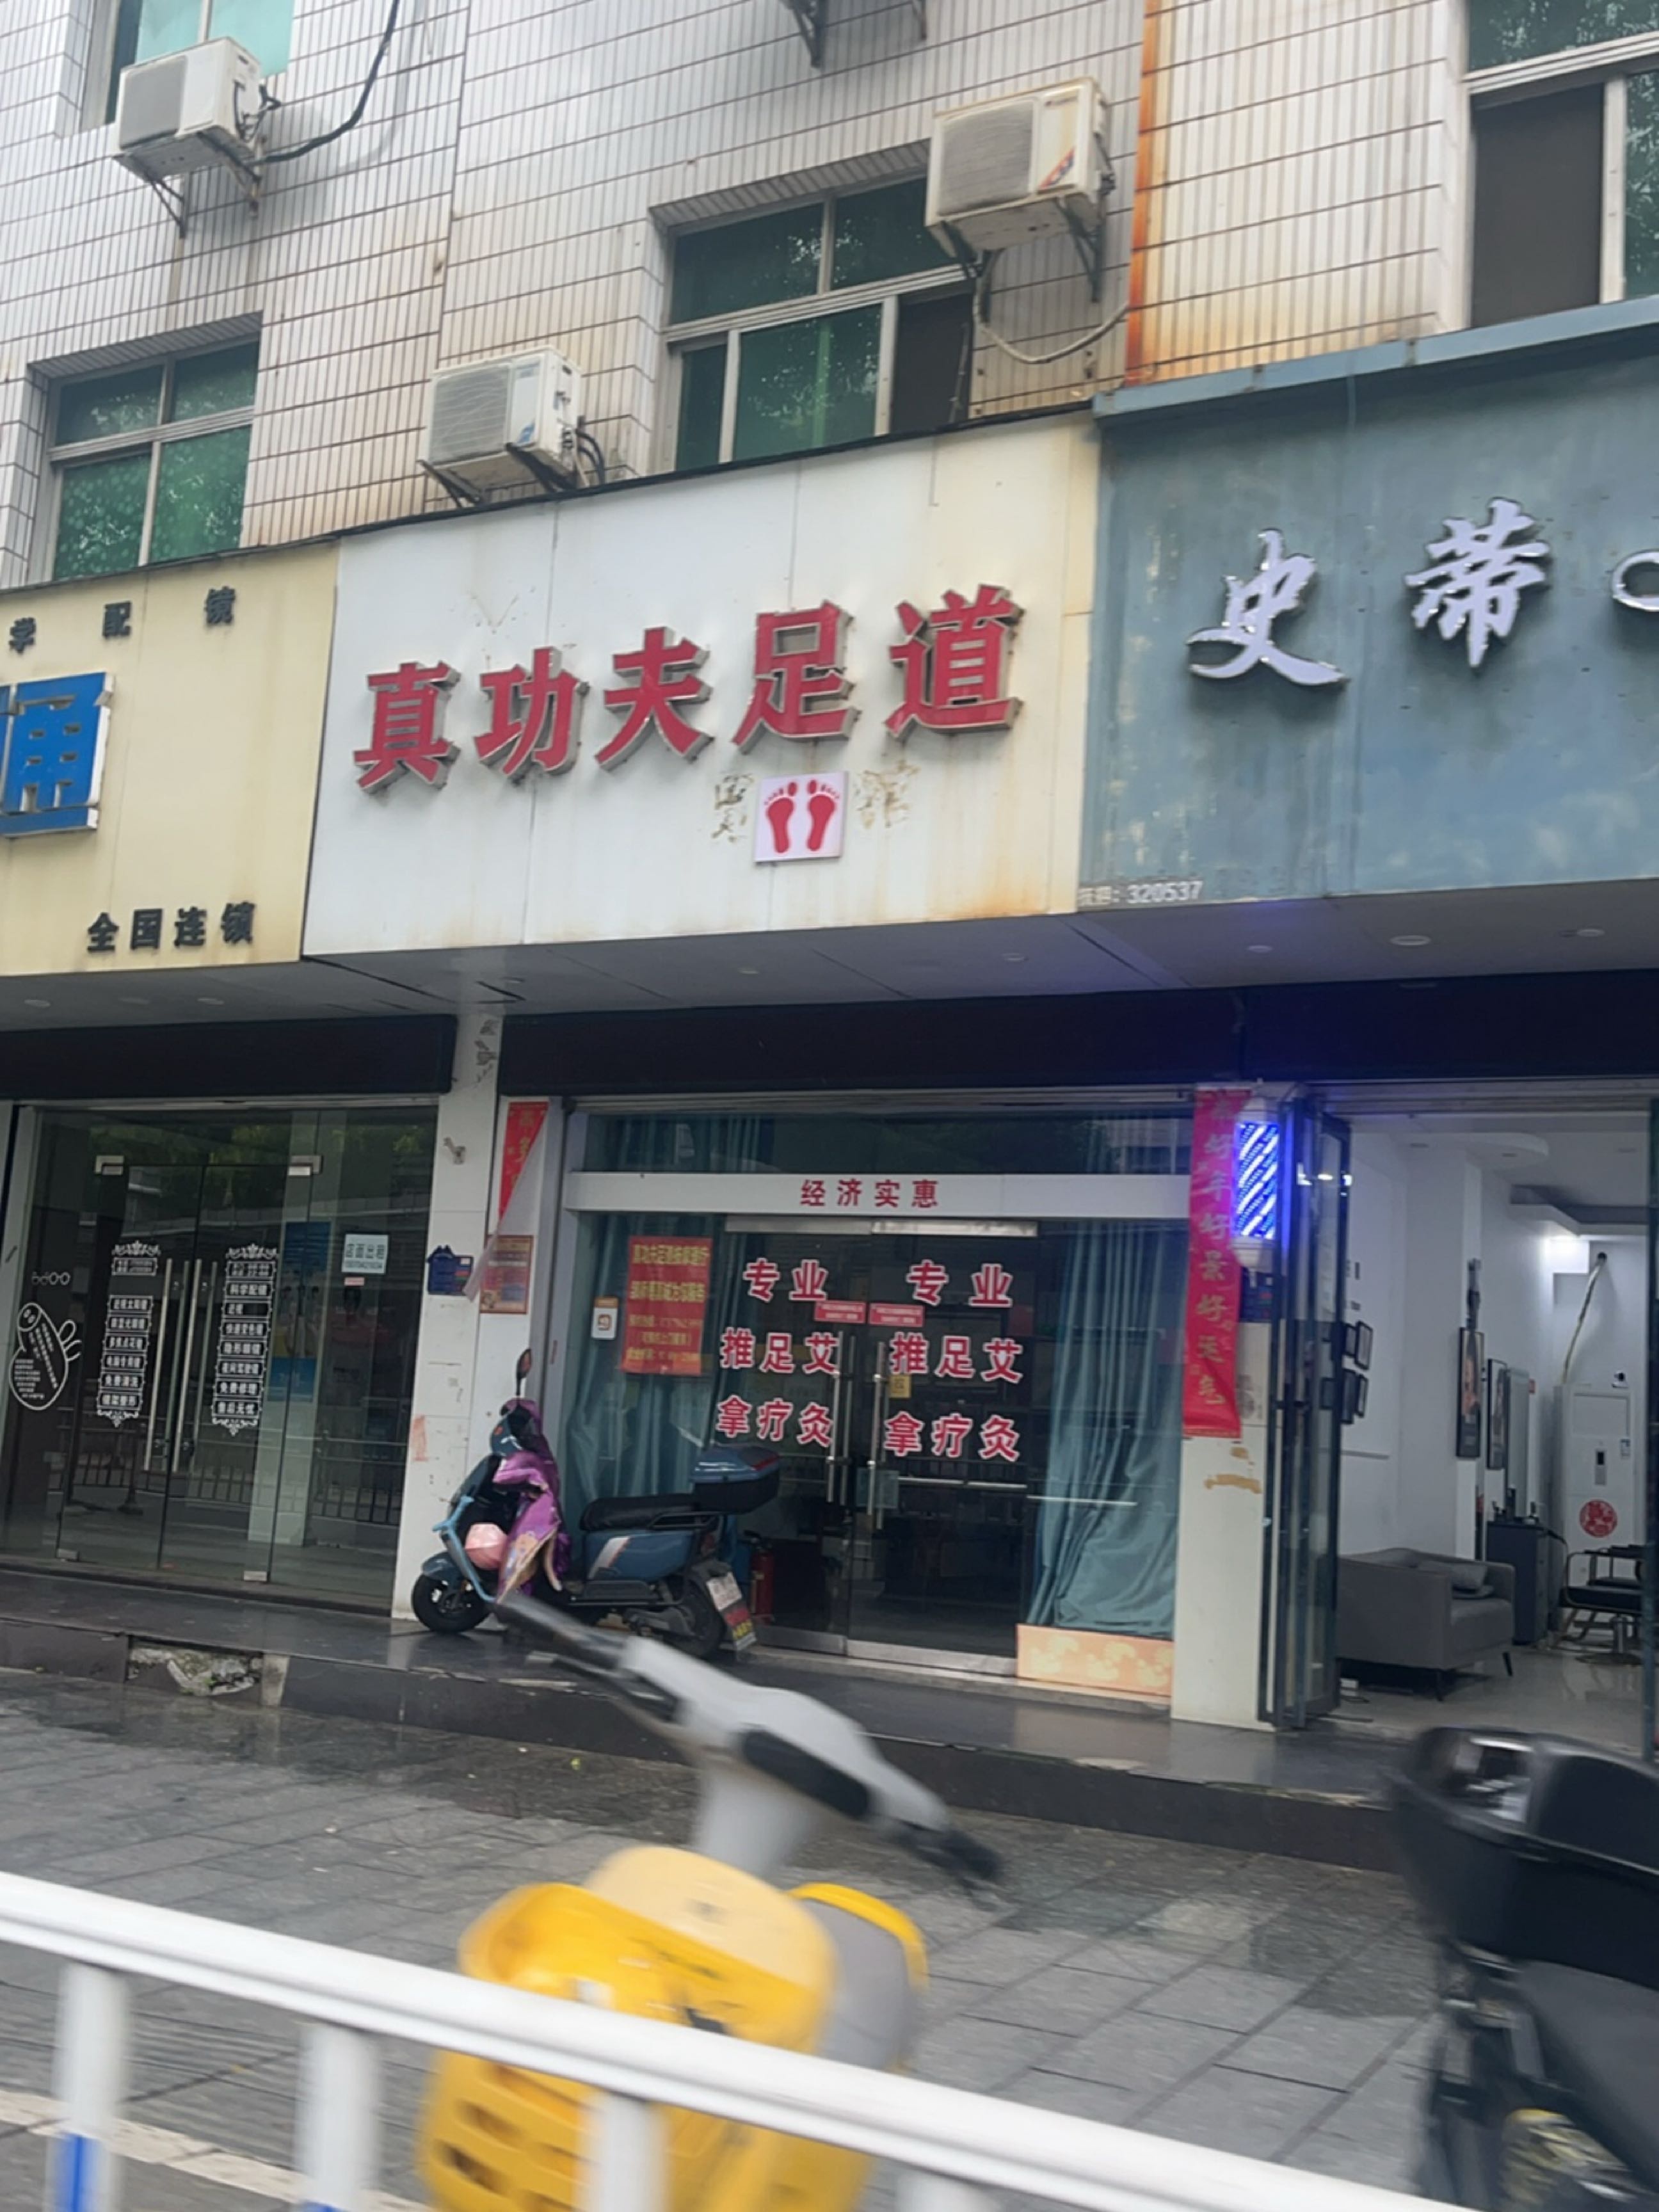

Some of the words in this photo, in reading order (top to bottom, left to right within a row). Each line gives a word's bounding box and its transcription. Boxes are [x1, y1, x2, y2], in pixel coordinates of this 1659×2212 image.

[353, 584, 1025, 795] 真功夫足道
[87, 901, 255, 954] 全国连锁
[800, 1178, 940, 1208] 经济实惠
[744, 1257, 828, 1302] 专业
[906, 1260, 1013, 1308] 专业
